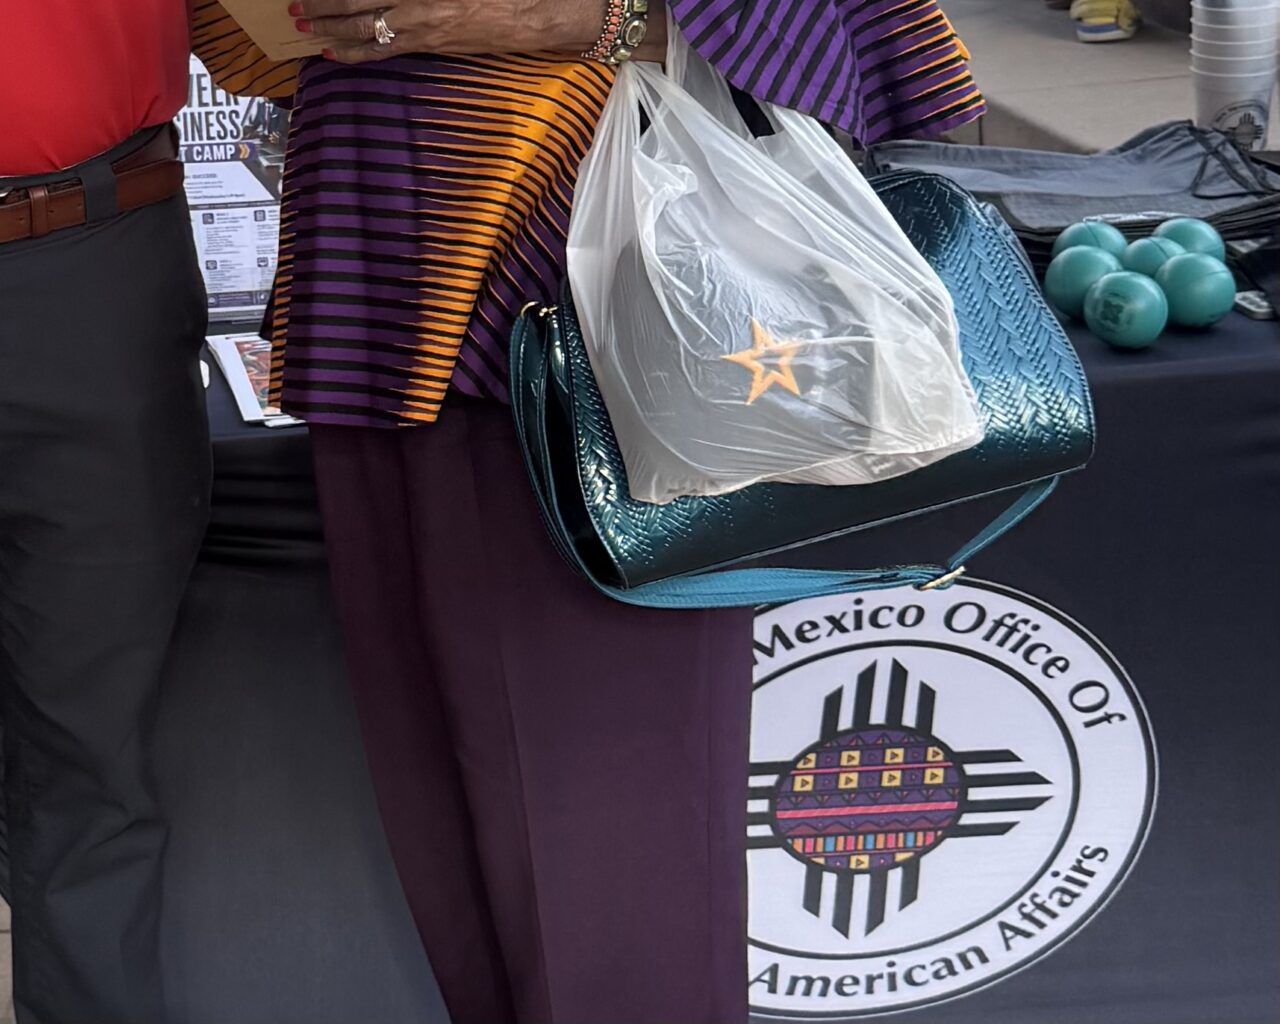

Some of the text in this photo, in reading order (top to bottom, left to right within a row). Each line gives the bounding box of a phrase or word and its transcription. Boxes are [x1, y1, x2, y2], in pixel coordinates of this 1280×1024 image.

[176, 109, 241, 143] INESS
[192, 144, 236, 161] CAMP
[753, 597, 1127, 729] Mexico Office Of
[749, 843, 1110, 999] American Affairs
